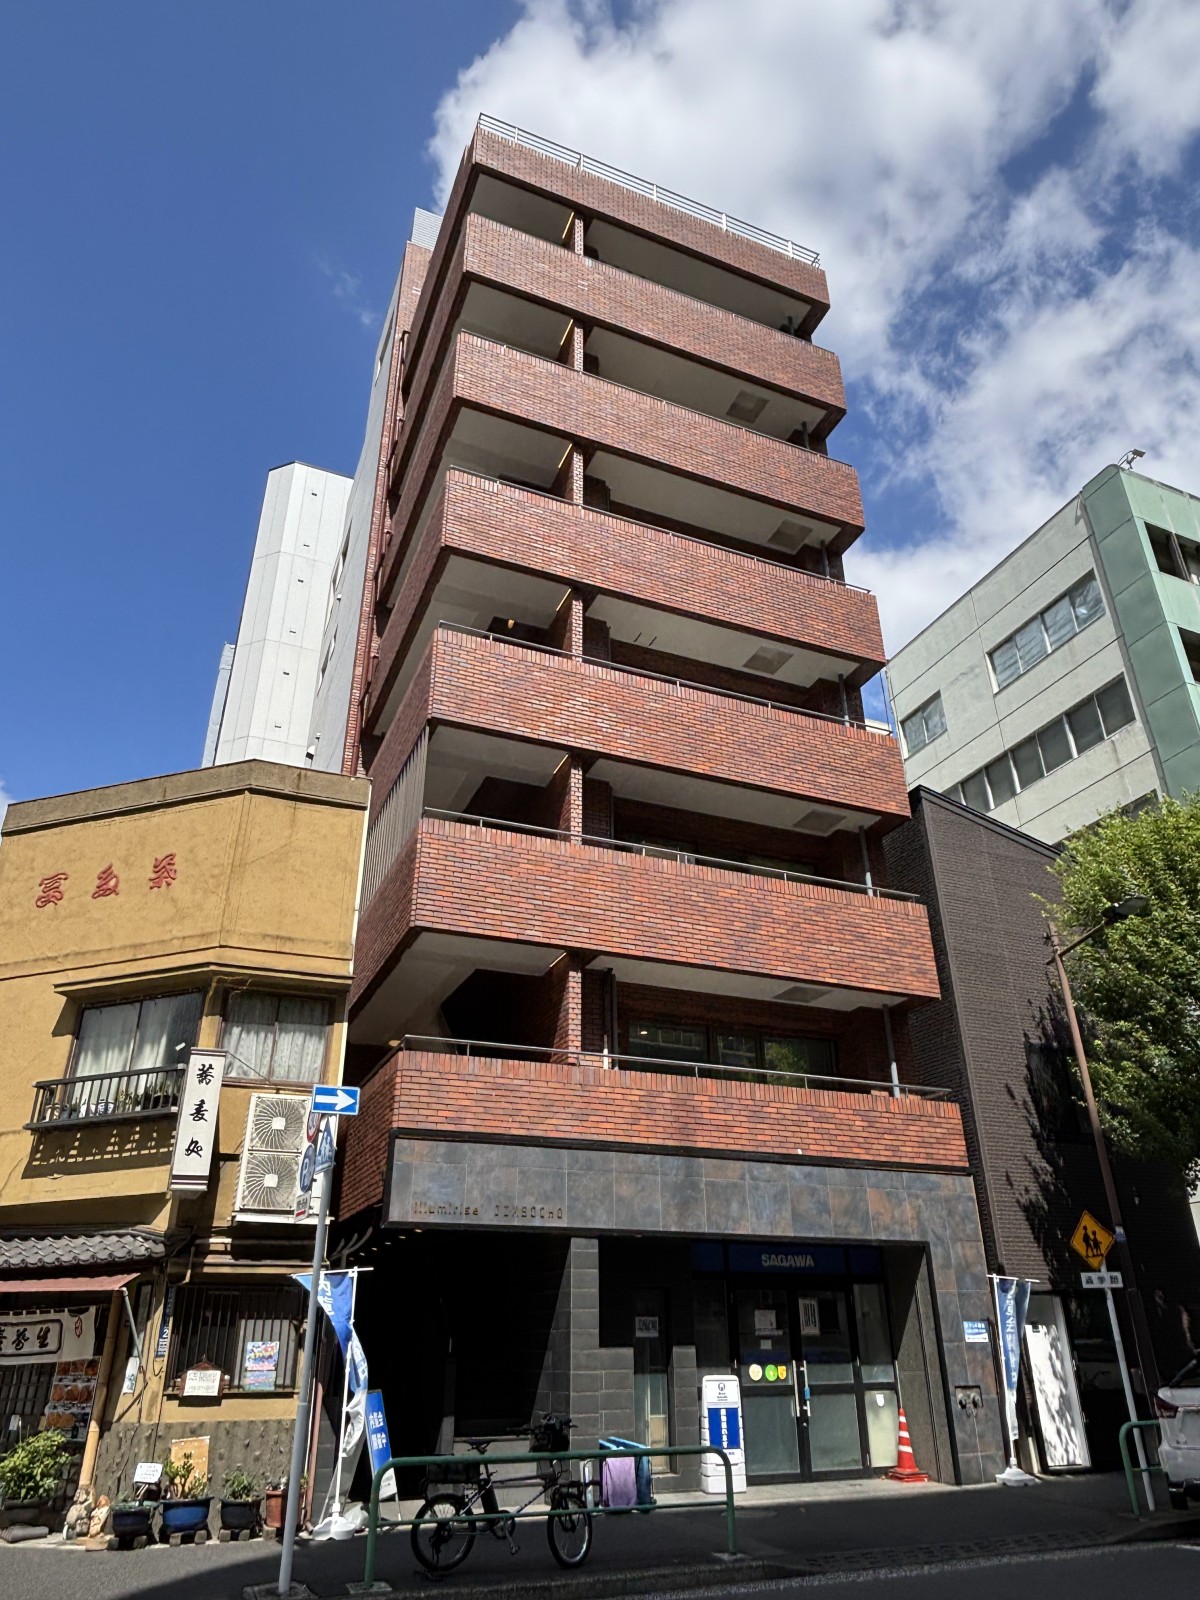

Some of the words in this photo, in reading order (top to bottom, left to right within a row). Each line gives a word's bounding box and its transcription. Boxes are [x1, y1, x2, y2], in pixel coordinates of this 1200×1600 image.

[761, 1253, 815, 1267] SAGAWA
[1085, 1275, 1120, 1285] 通学路
